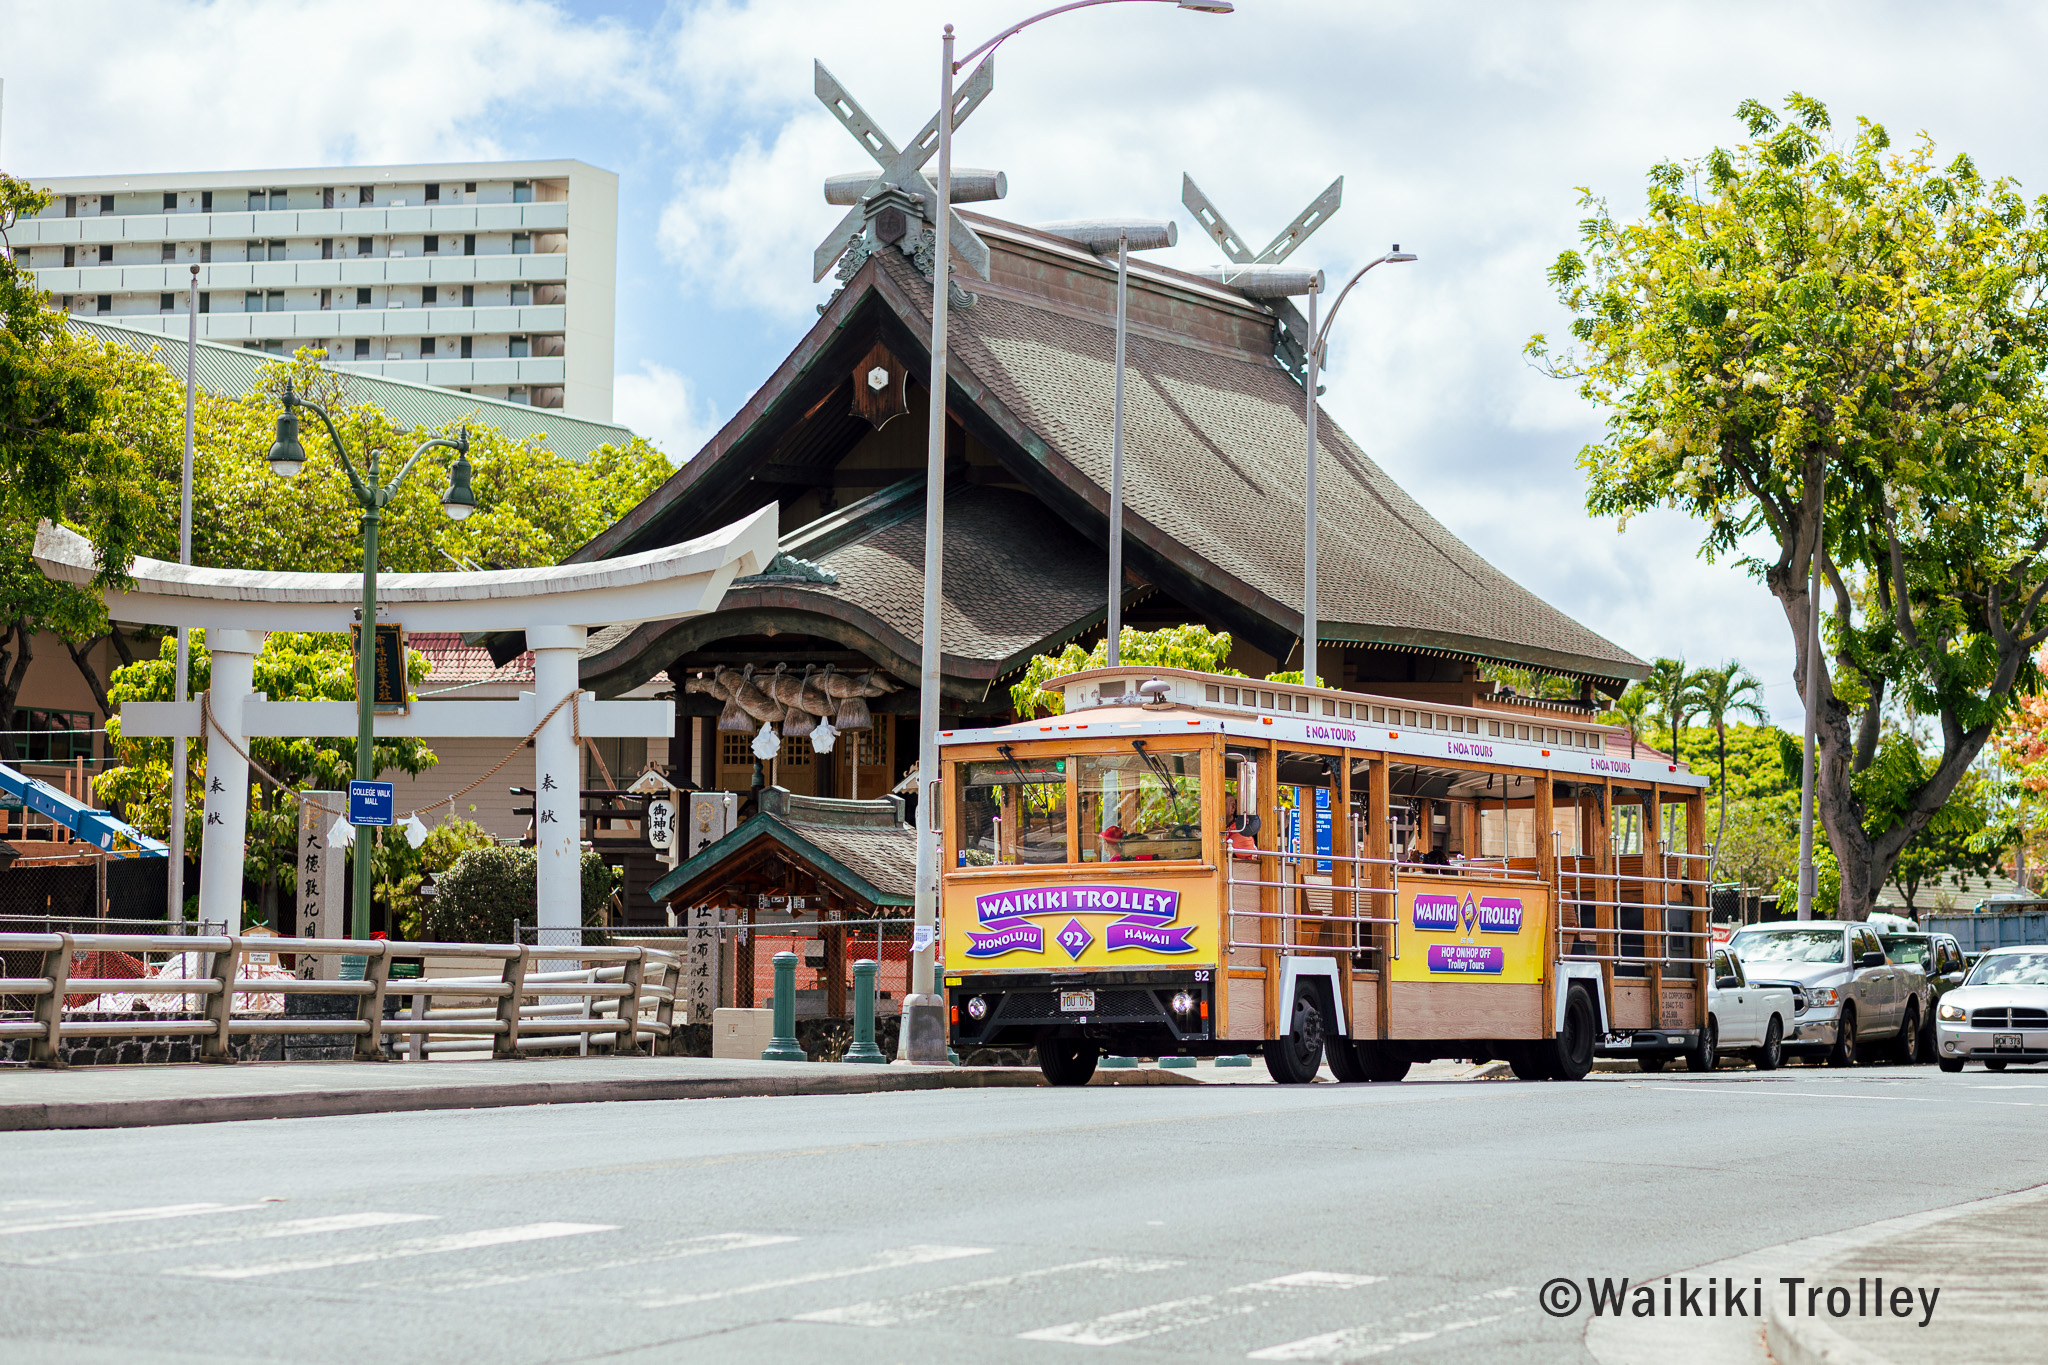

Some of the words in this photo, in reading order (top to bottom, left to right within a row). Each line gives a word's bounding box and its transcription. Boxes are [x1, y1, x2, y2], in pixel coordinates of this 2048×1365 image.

[1306, 725, 1311, 738] E
[1312, 726, 1330, 740] NOA
[1330, 727, 1356, 742] TOURS
[1448, 741, 1452, 753] E
[1453, 742, 1470, 755] NOA
[1469, 743, 1493, 758] TOURS
[1591, 758, 1595, 770] E
[1596, 759, 1610, 771] NOA
[1610, 760, 1631, 774] TOURS
[352, 787, 376, 797] COLLEGE
[376, 789, 391, 798] WALK
[364, 797, 379, 806] MALL
[652, 803, 668, 842] 御神燈
[981, 891, 1068, 918] WAIKIKI
[1072, 890, 1172, 913] TROLLEY
[1415, 902, 1458, 922] WAIKIKI
[1479, 906, 1522, 925] TROLLEY
[978, 931, 1037, 949] HONOLULU
[1063, 931, 1084, 947] 92
[1124, 929, 1170, 945] HAWAII
[1441, 946, 1455, 958] HOP
[1479, 948, 1492, 959] OFF
[1447, 958, 1468, 972] Trolley
[1468, 959, 1485, 970] Tours
[1194, 970, 1209, 982] 92
[1669, 992, 1693, 1000] CORPORATION
